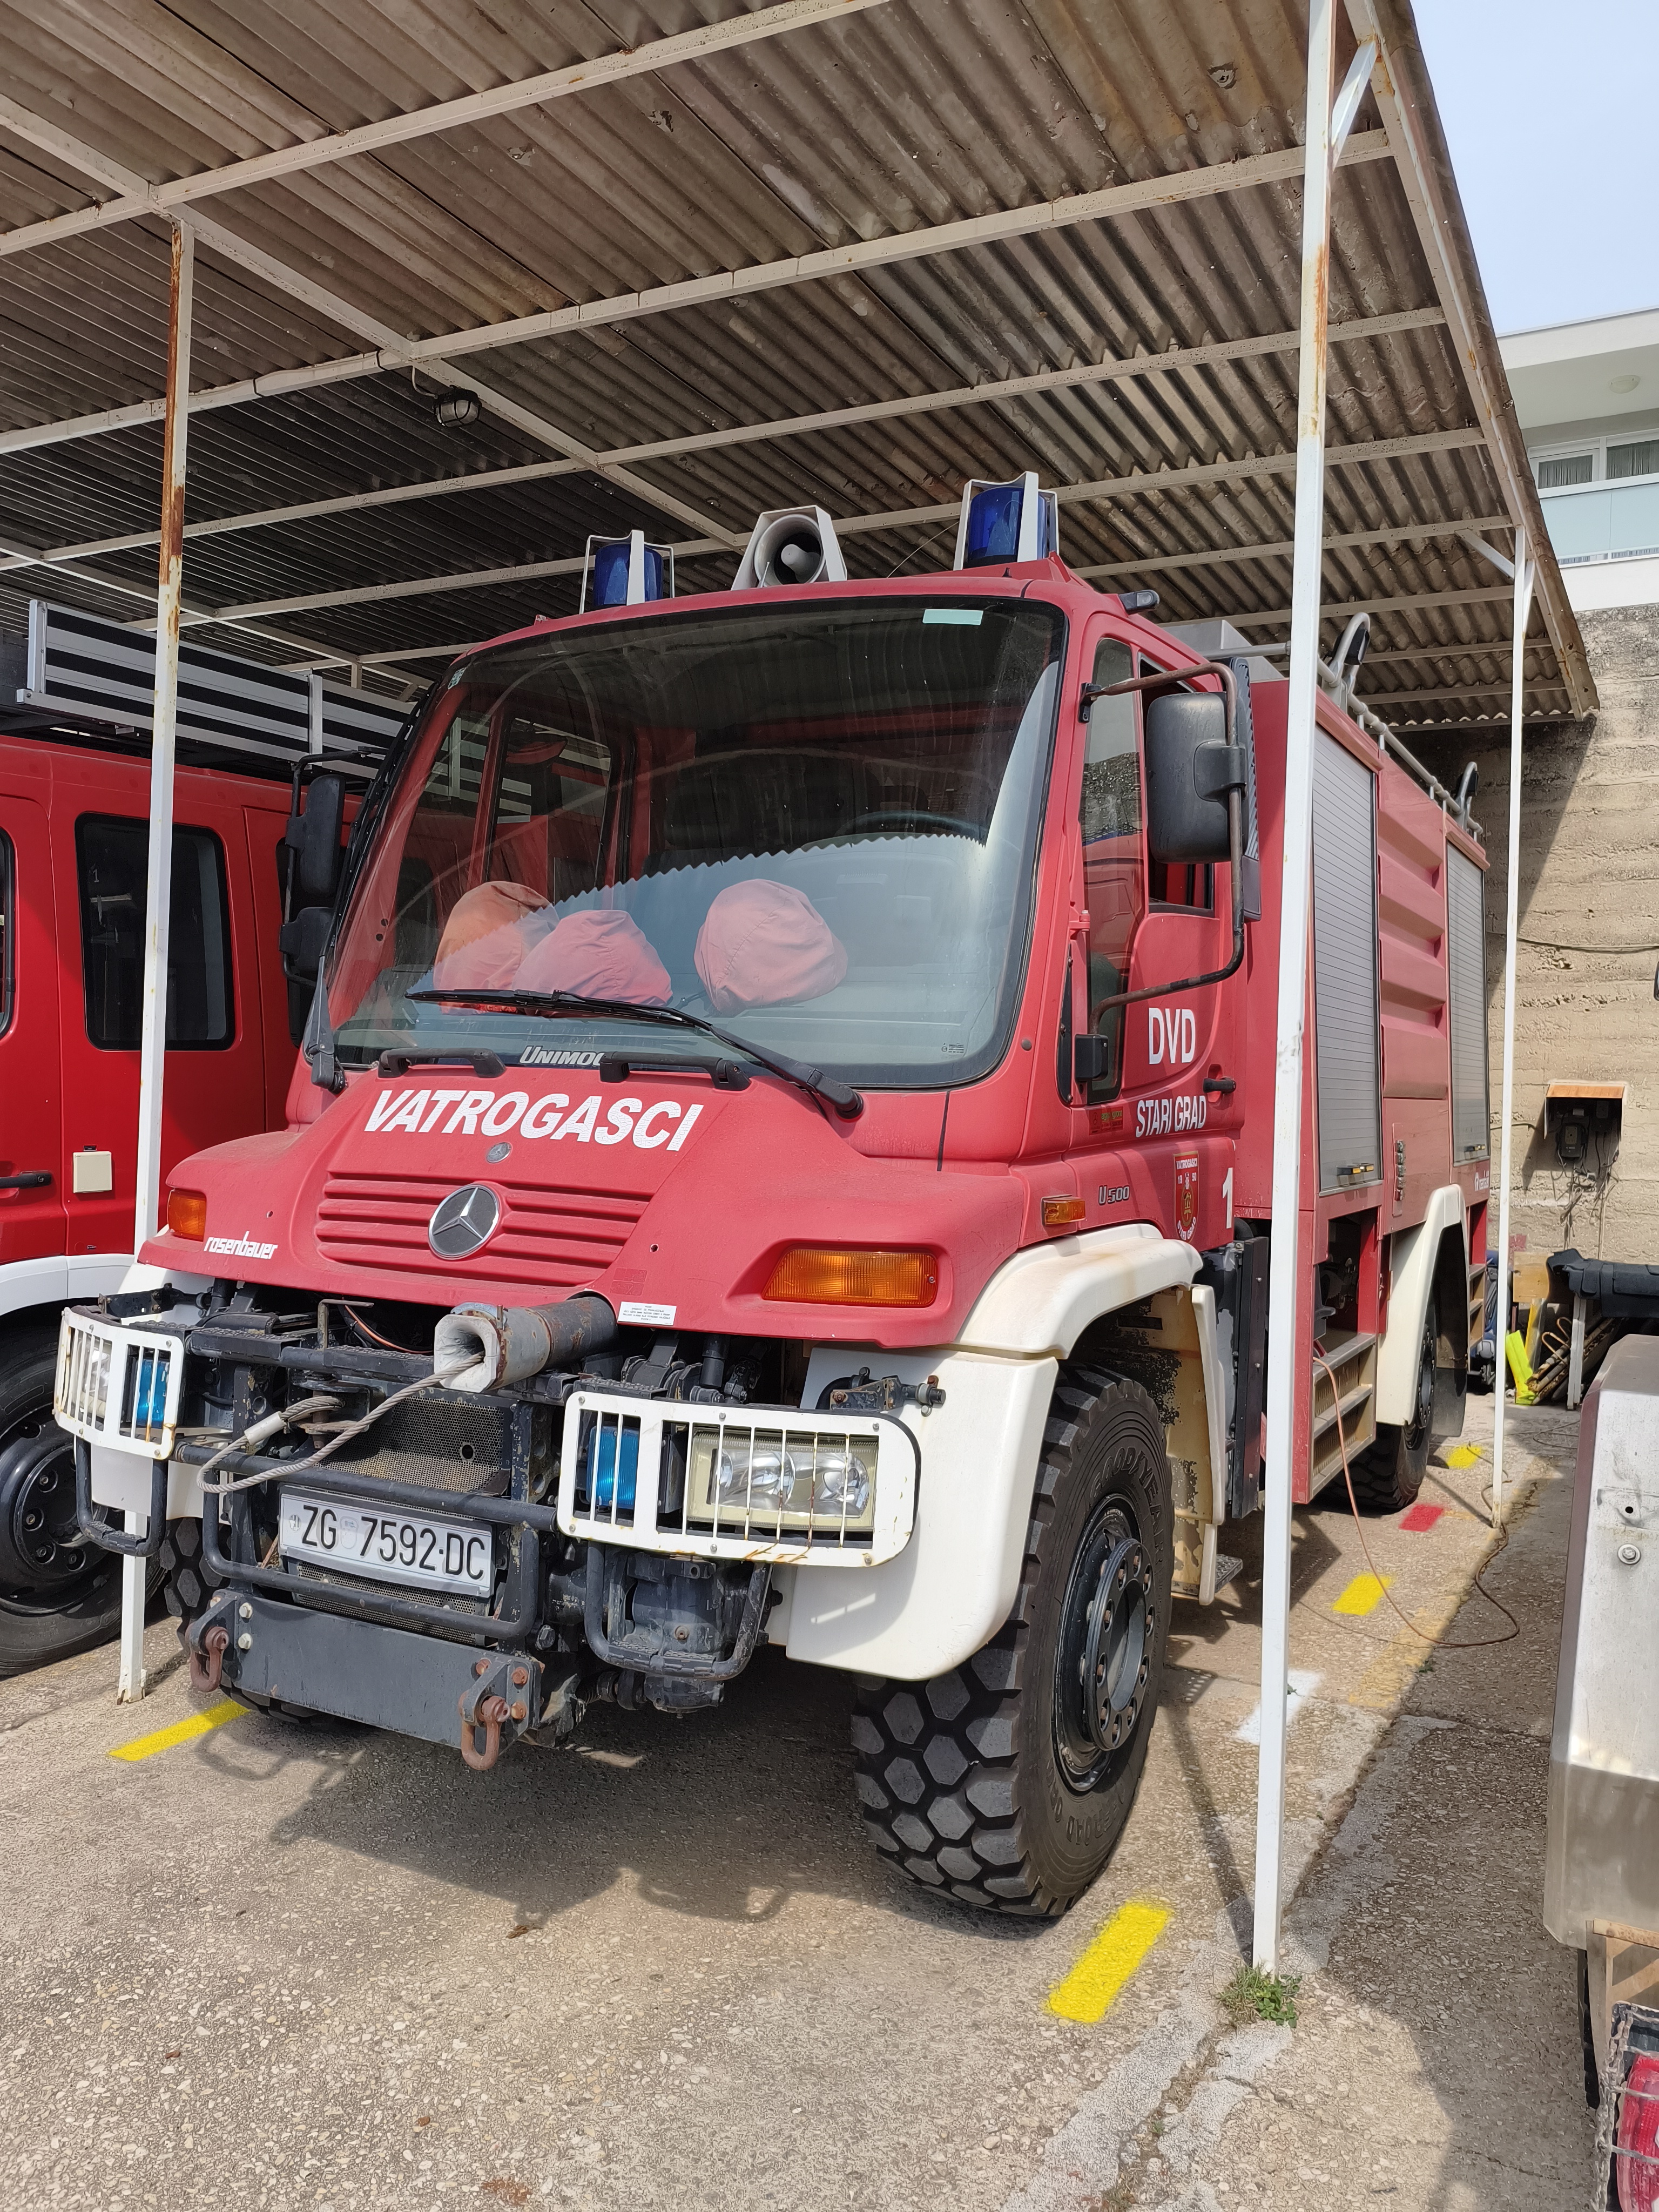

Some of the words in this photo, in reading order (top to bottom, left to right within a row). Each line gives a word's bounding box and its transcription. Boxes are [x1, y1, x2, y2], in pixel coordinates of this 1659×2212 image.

[1149, 1007, 1196, 1064] DVD
[363, 1089, 704, 1151] VATROGASCI
[1136, 1098, 1172, 1138] STARI
[1175, 1095, 1206, 1132] GRAD
[1176, 1157, 1198, 1170] VATROGASCI
[1178, 1175, 1183, 1184] 19
[1222, 1167, 1233, 1229] 1
[204, 1230, 278, 1259] rosenbauer
[1177, 1220, 1187, 1240] STARI
[302, 1505, 337, 1549] ZG
